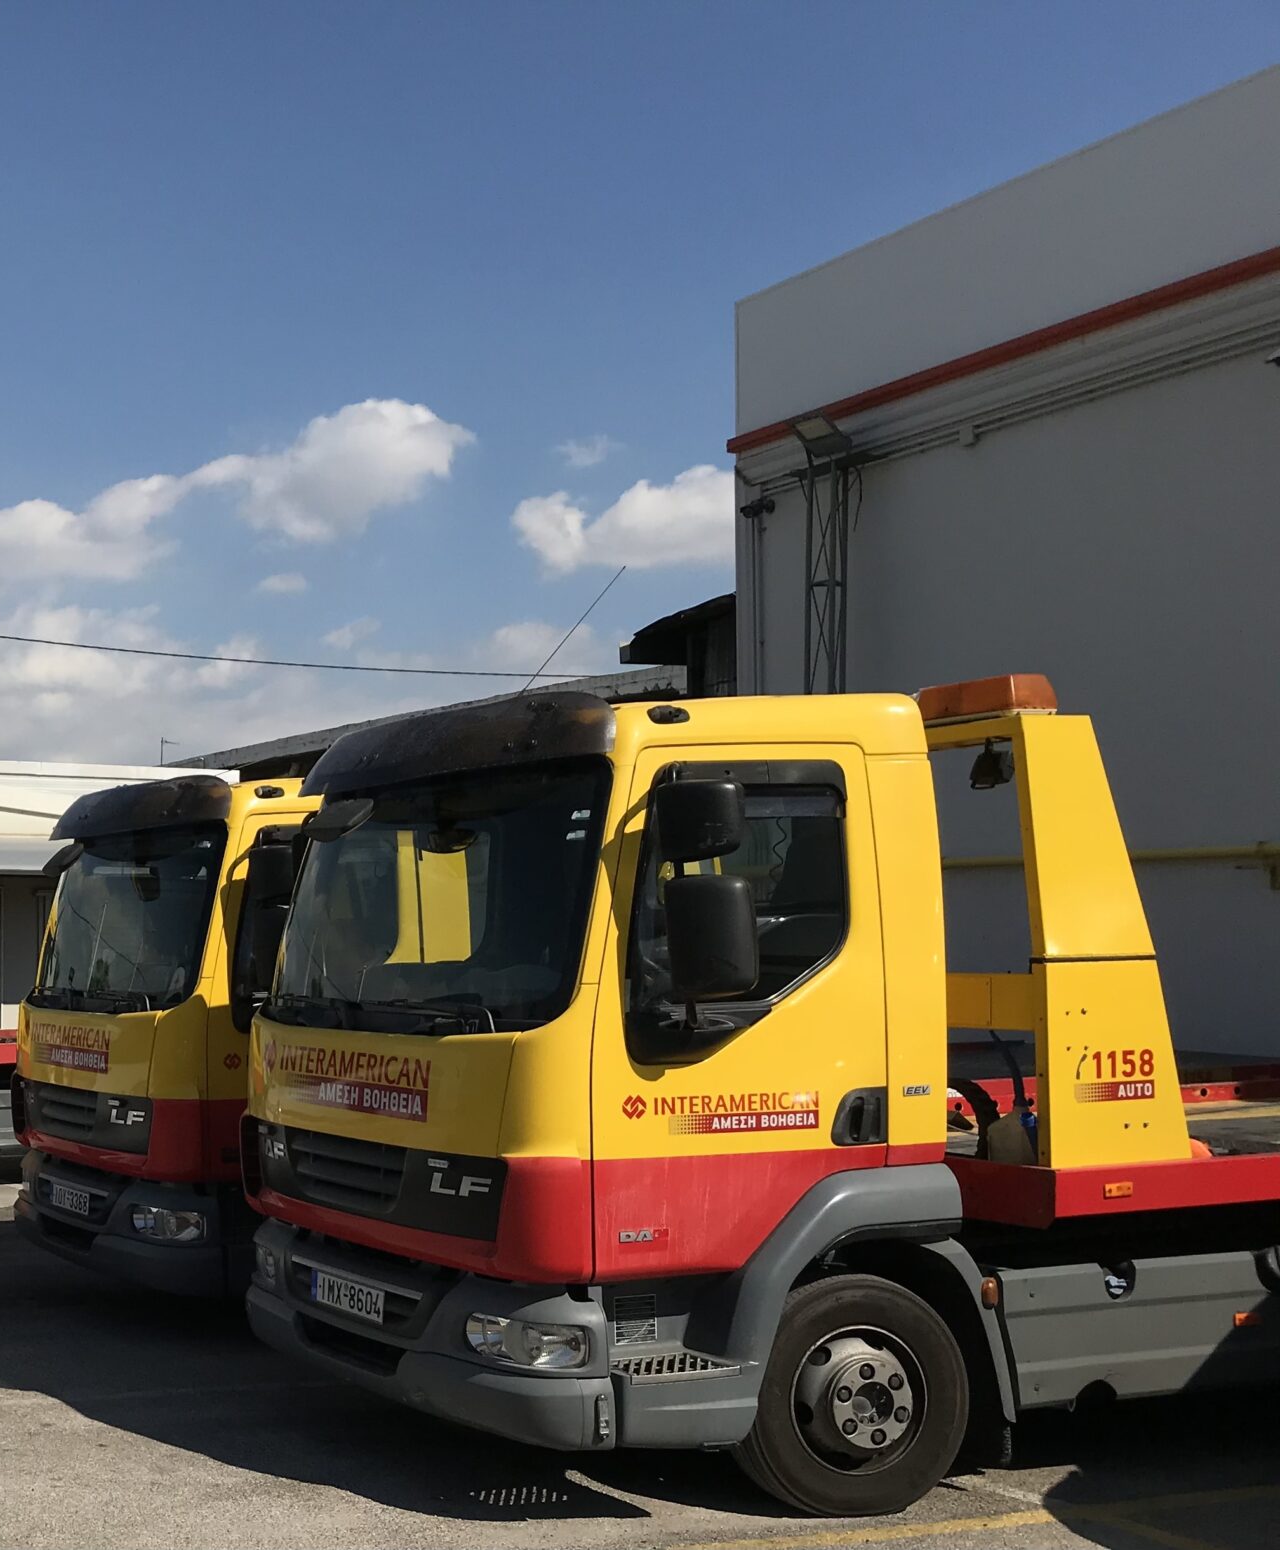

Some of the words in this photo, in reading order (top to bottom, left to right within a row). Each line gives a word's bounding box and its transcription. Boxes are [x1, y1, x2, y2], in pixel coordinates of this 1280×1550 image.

[31, 1021, 112, 1051] INTERAMERICAN
[280, 1044, 432, 1089] INTERAMERICAN
[1092, 1048, 1155, 1079] 1158
[318, 1082, 359, 1106] ΑΜΕΣΗ
[363, 1089, 422, 1116] ΒΟΗΘΕΙΑ
[905, 1085, 930, 1095] EEV
[1117, 1083, 1153, 1098] AUTO
[654, 1090, 820, 1116] INTERAMERICAN
[110, 1108, 146, 1126] LF
[711, 1113, 757, 1130] ΑΜΕΣΗ
[761, 1112, 816, 1127] ΒΟΗΘΕΙΑ
[429, 1172, 492, 1197] LF
[619, 1229, 658, 1244] DA
[322, 1276, 381, 1319] IMX-8604
